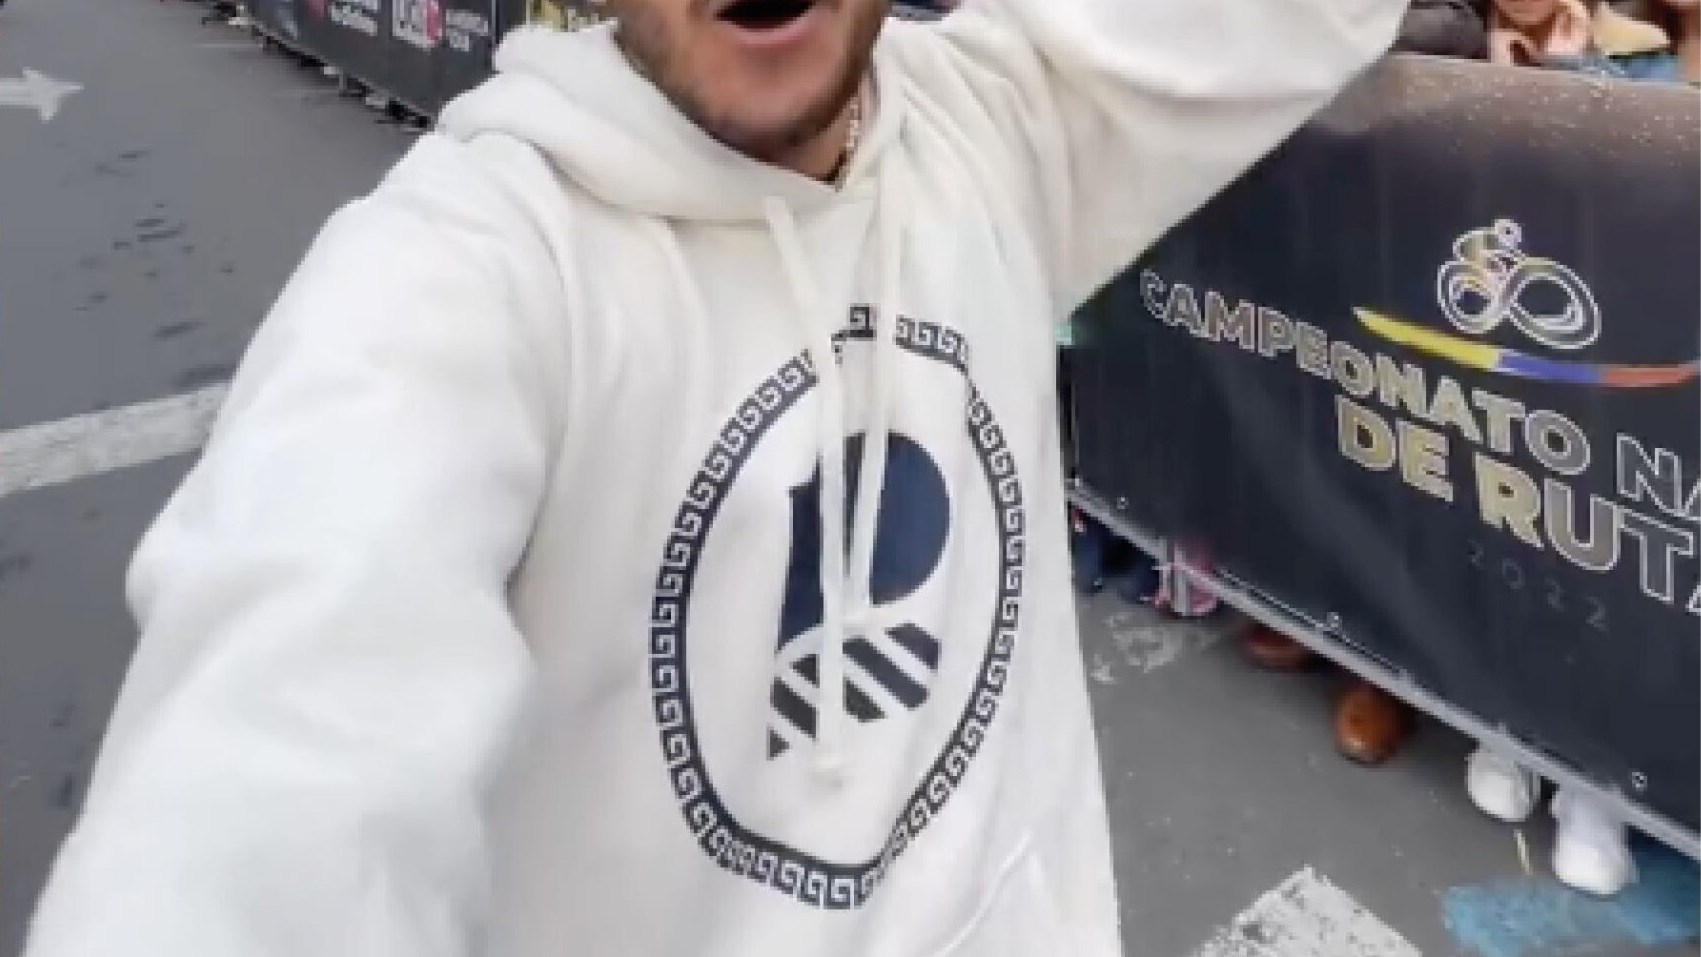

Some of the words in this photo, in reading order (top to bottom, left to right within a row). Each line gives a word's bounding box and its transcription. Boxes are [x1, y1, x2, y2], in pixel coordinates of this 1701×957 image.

[1138, 267, 1593, 476] CAMPEONATO
[1334, 394, 1456, 503] DE
[1475, 452, 1701, 616] RUT
[1466, 541, 1609, 632] 2022
